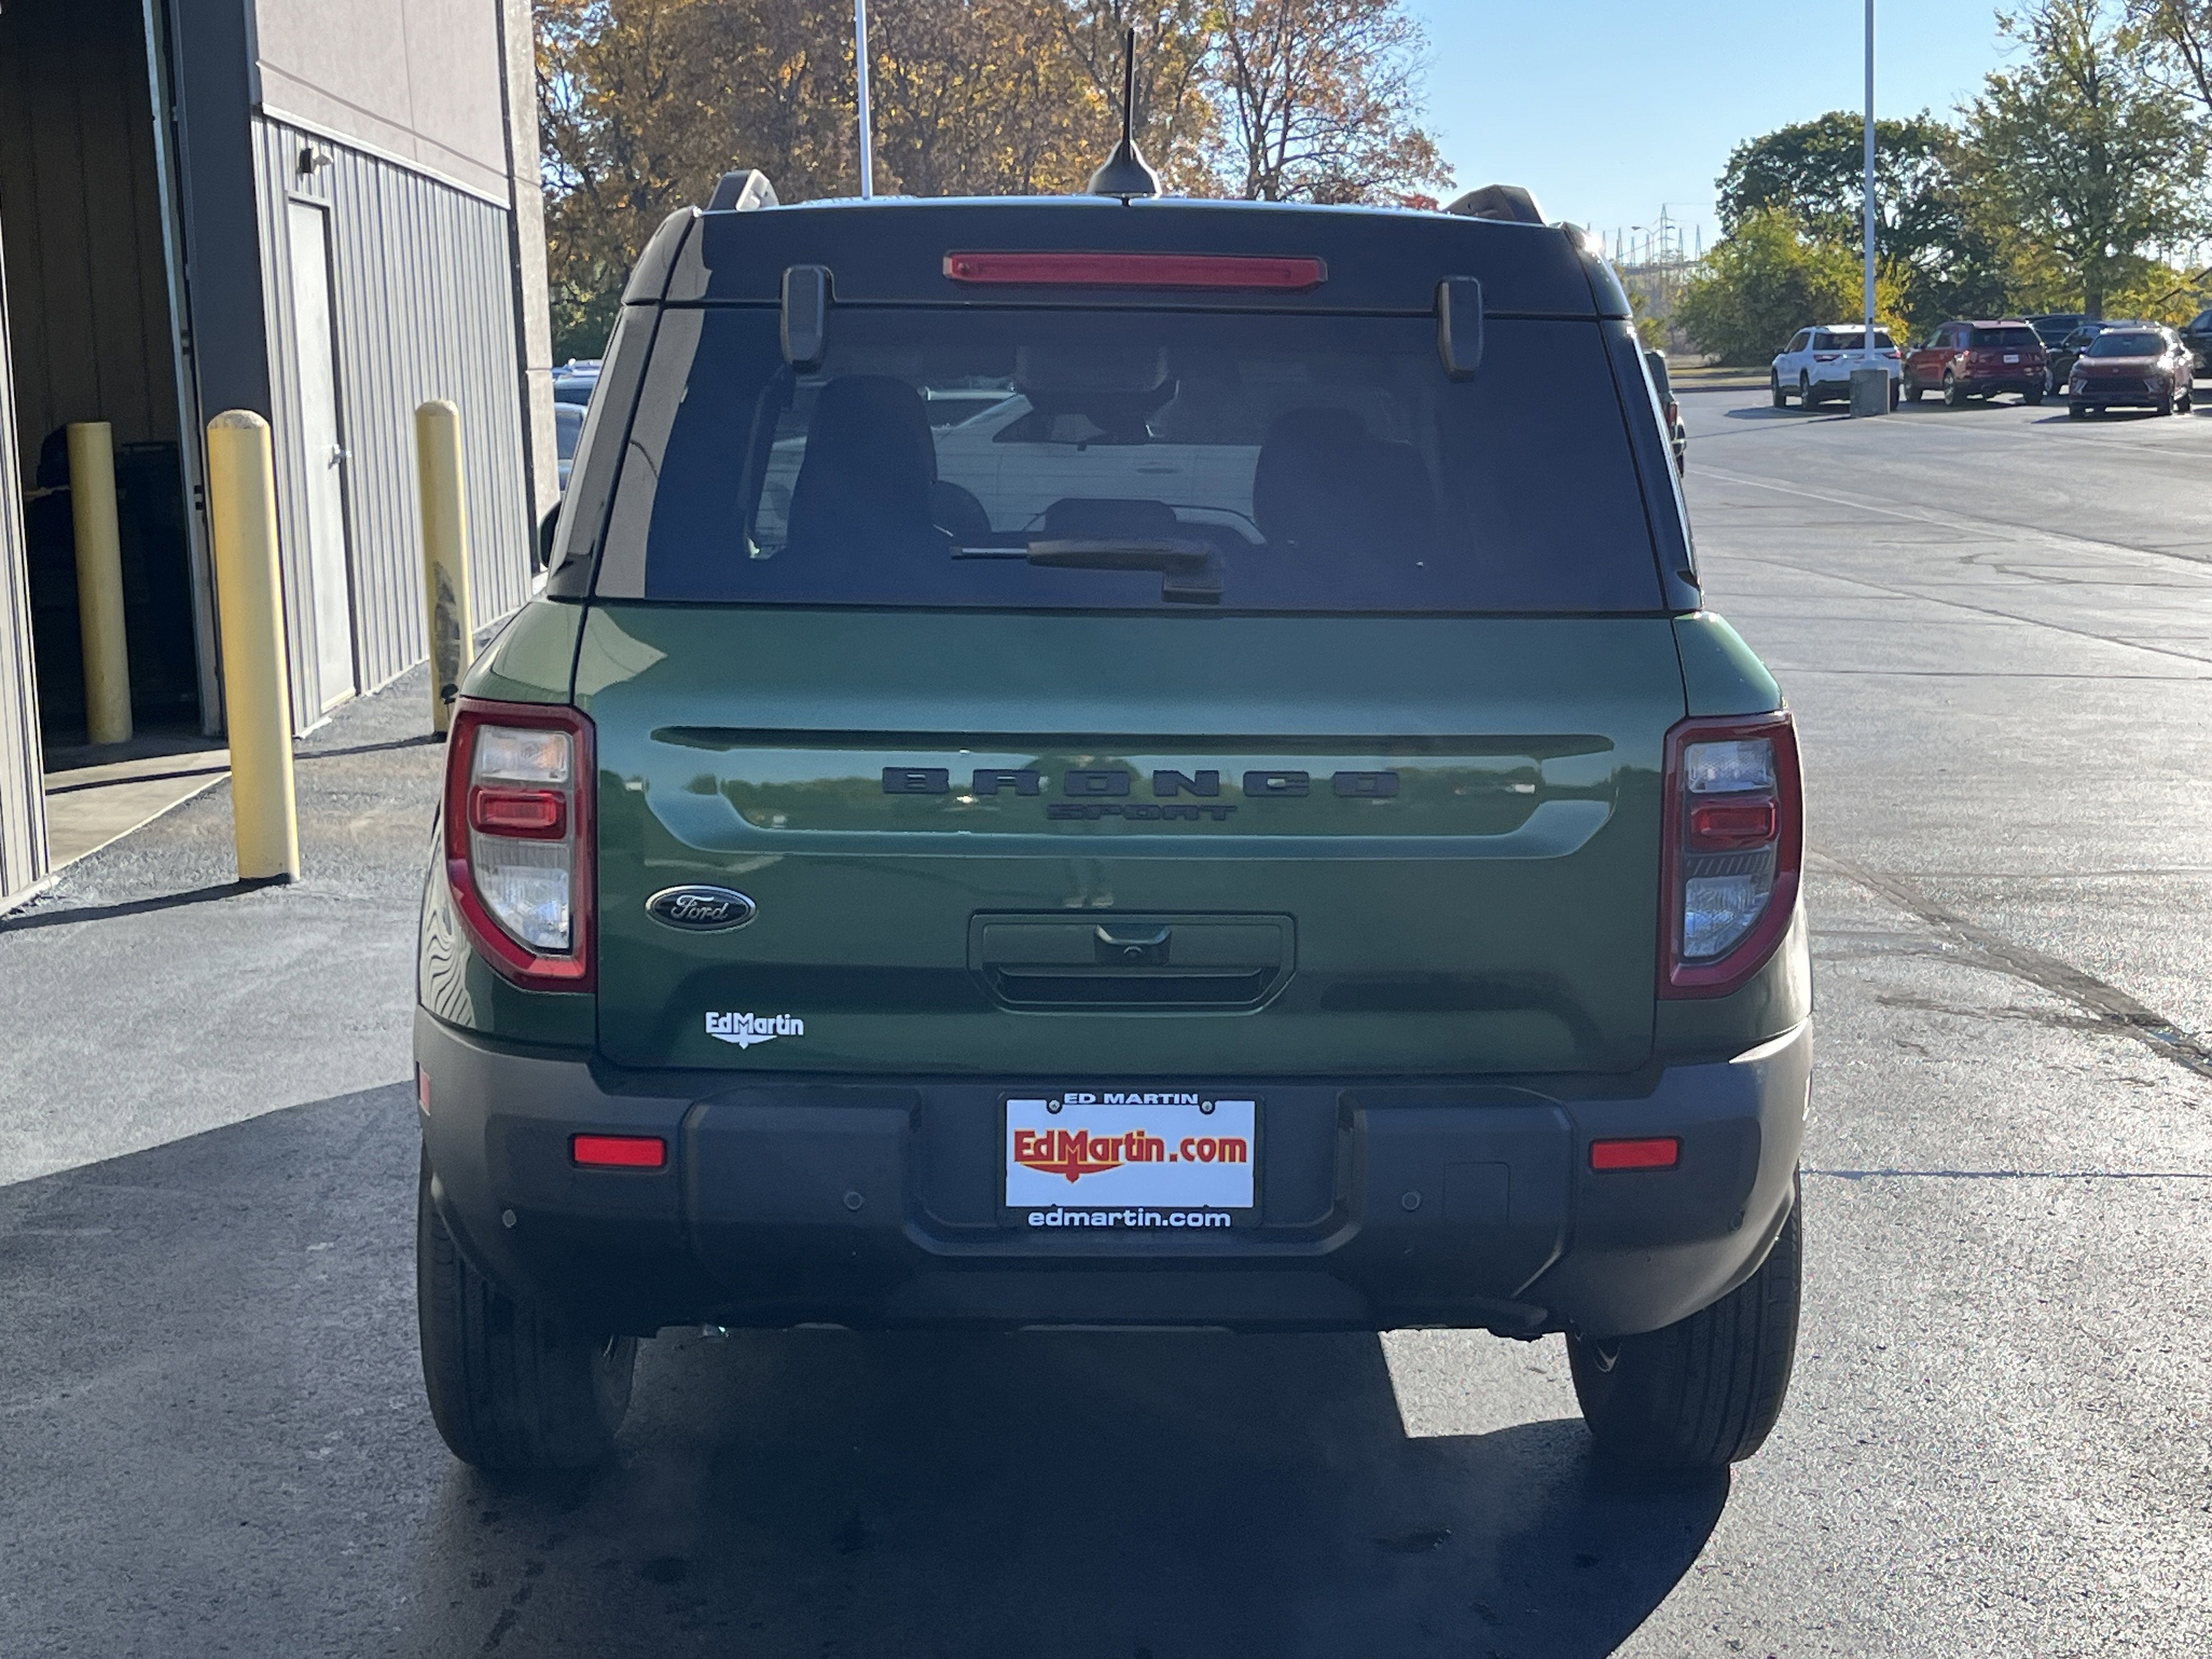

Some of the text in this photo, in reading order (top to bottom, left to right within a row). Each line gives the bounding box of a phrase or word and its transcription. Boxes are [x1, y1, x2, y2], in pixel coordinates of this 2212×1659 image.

[882, 768, 1400, 797] BRONCO
[1047, 804, 1238, 821] SPORT
[670, 894, 728, 921] Ford
[1063, 1093, 1199, 1105] ED MARTIN
[1014, 1128, 1248, 1163] EdMartin.com
[1028, 1208, 1231, 1228] edmartin.com
